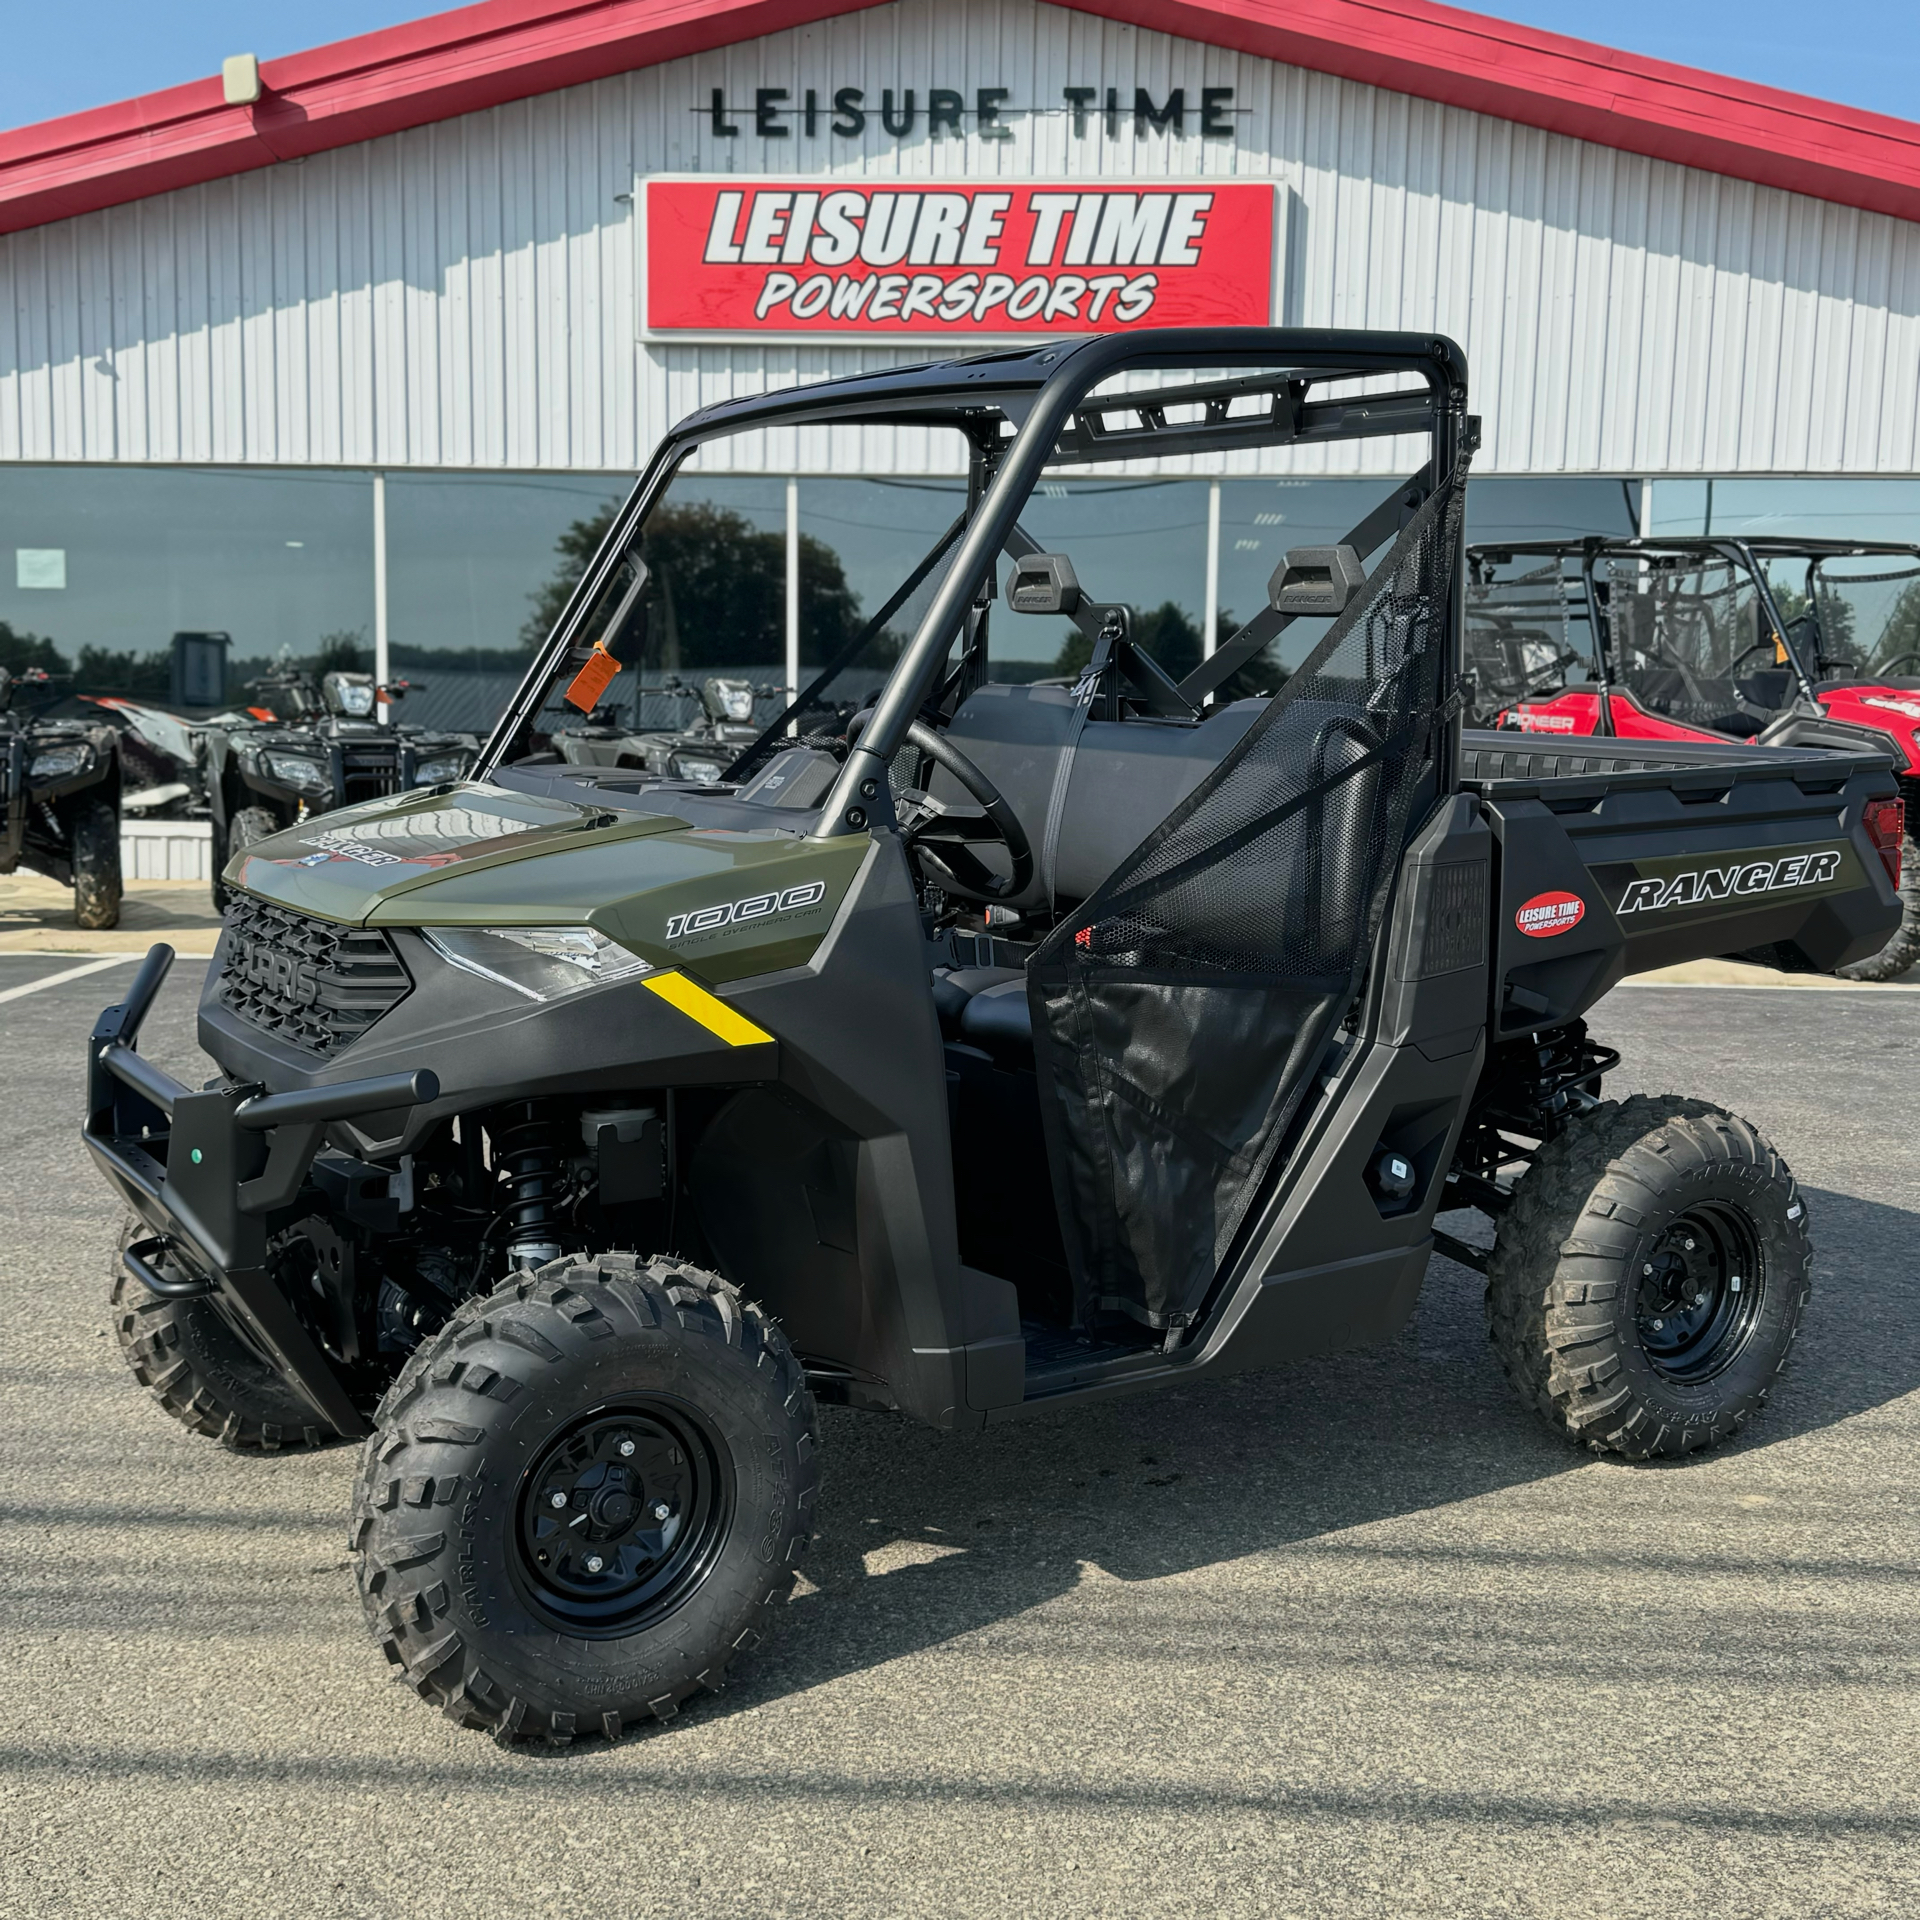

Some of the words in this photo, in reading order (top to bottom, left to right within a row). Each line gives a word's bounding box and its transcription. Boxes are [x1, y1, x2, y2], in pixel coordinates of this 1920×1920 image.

[711, 87, 1012, 139] LEISURE
[1062, 87, 1235, 138] TIME
[703, 191, 1012, 266] LEISURE
[1025, 191, 1214, 266] TIME
[755, 272, 1159, 323] POWERSPORTS
[1283, 595, 1332, 604] RANGER
[1507, 712, 1575, 730] PIONEER
[299, 831, 402, 867] RANGER
[1616, 850, 1841, 915] RANGER
[665, 880, 826, 940] 1000
[668, 932, 718, 950] SINGLE
[722, 916, 791, 937] OVERHEAD
[794, 907, 822, 919] CAM
[1519, 905, 1557, 924] LEISURE
[1558, 900, 1580, 917] TIME
[1524, 915, 1575, 932] POWERSPORTS
[226, 930, 317, 1006] POLARIS
[457, 1457, 492, 1629] CARLISLE
